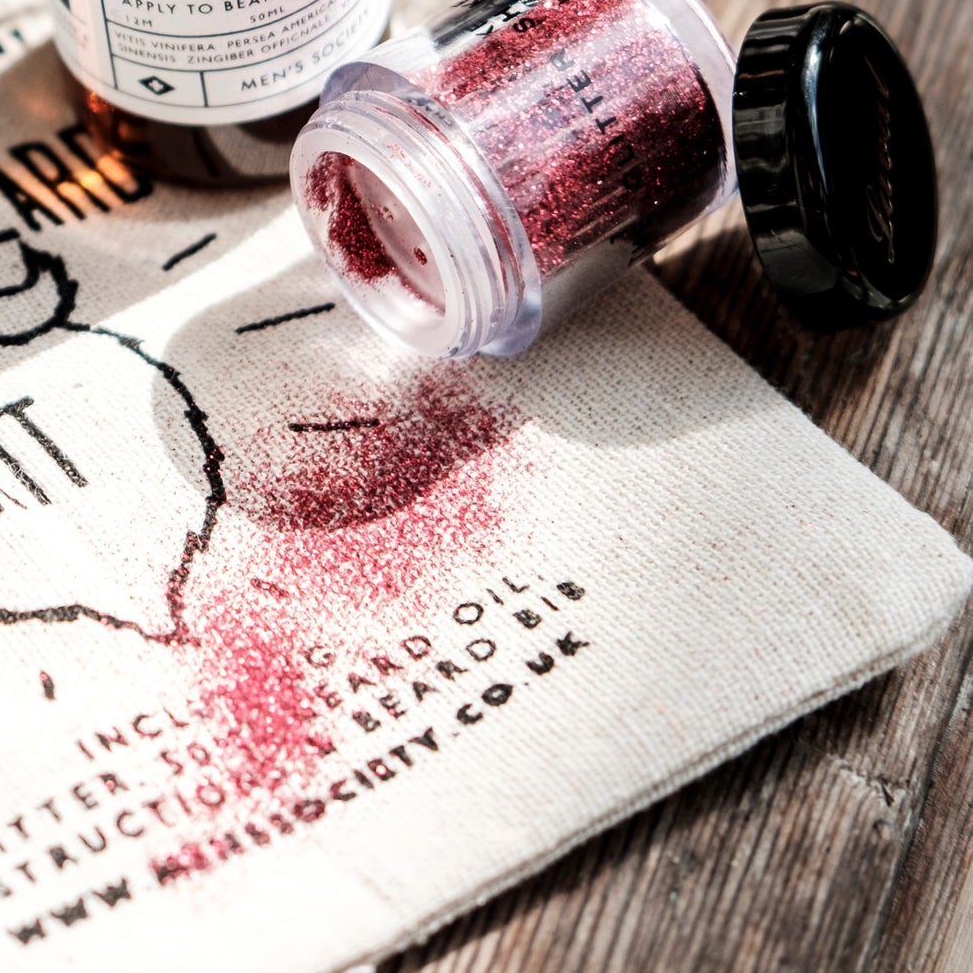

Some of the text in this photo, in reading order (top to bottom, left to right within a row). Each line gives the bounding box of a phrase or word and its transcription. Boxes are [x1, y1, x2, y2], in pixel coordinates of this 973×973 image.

[187, 3, 213, 15] TO
[249, 5, 286, 24] 50ML
[113, 30, 146, 47] VITIS
[150, 41, 216, 52] VINIFERA
[226, 30, 276, 49] PERSEA
[240, 6, 369, 92] MEN'S SOCIETY
[187, 49, 255, 64] ZINGIBER
[549, 47, 643, 191] GLITTER
[351, 637, 497, 733] BEARD
[512, 579, 585, 630] BIB
